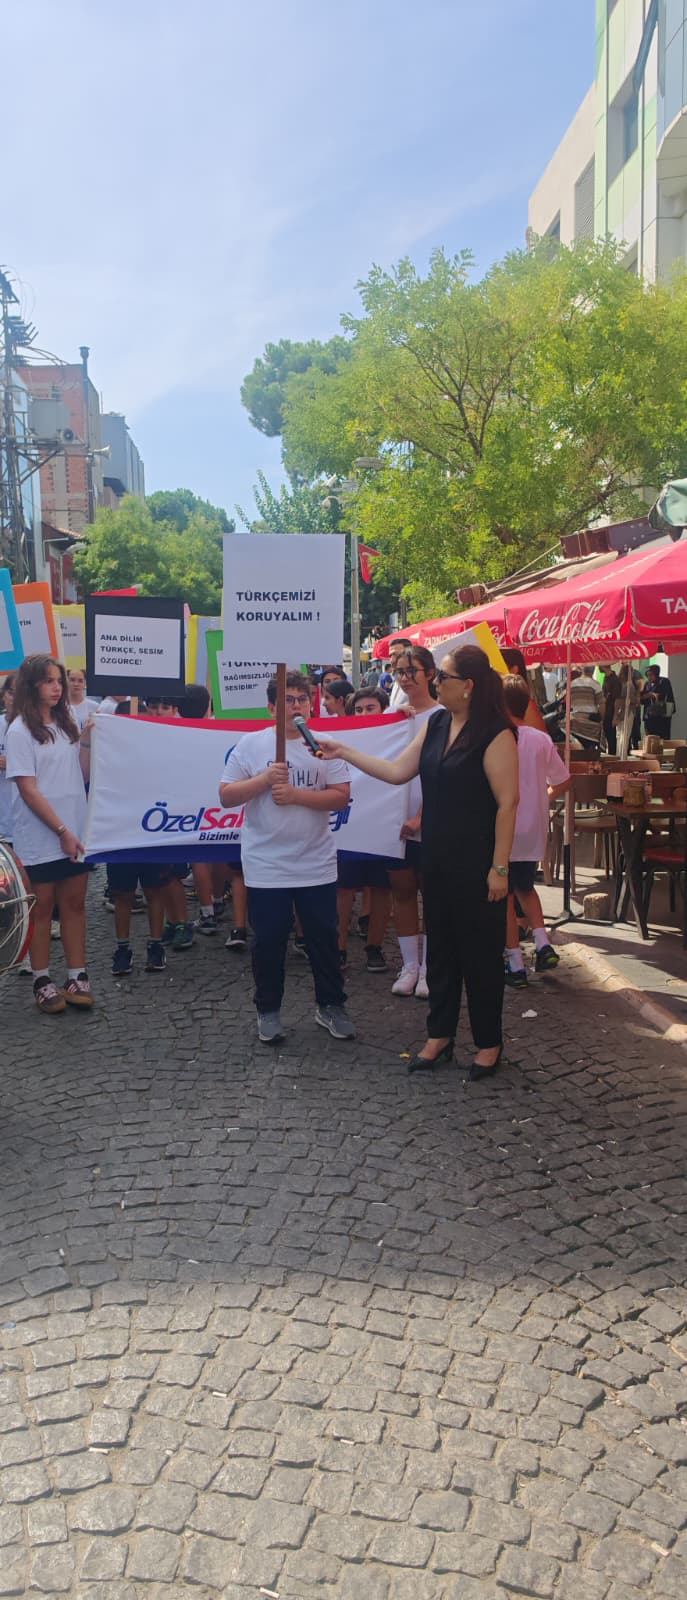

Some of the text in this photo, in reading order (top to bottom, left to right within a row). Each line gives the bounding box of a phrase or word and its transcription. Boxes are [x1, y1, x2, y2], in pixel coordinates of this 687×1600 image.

[236, 589, 316, 603] TÜRKÇEMİZİ
[236, 611, 320, 622] KORUYALIM !
[100, 634, 143, 643] ANA DİLİM
[100, 645, 164, 656] TÜRKÇE, SESİM
[198, 831, 240, 841] Bizimle
